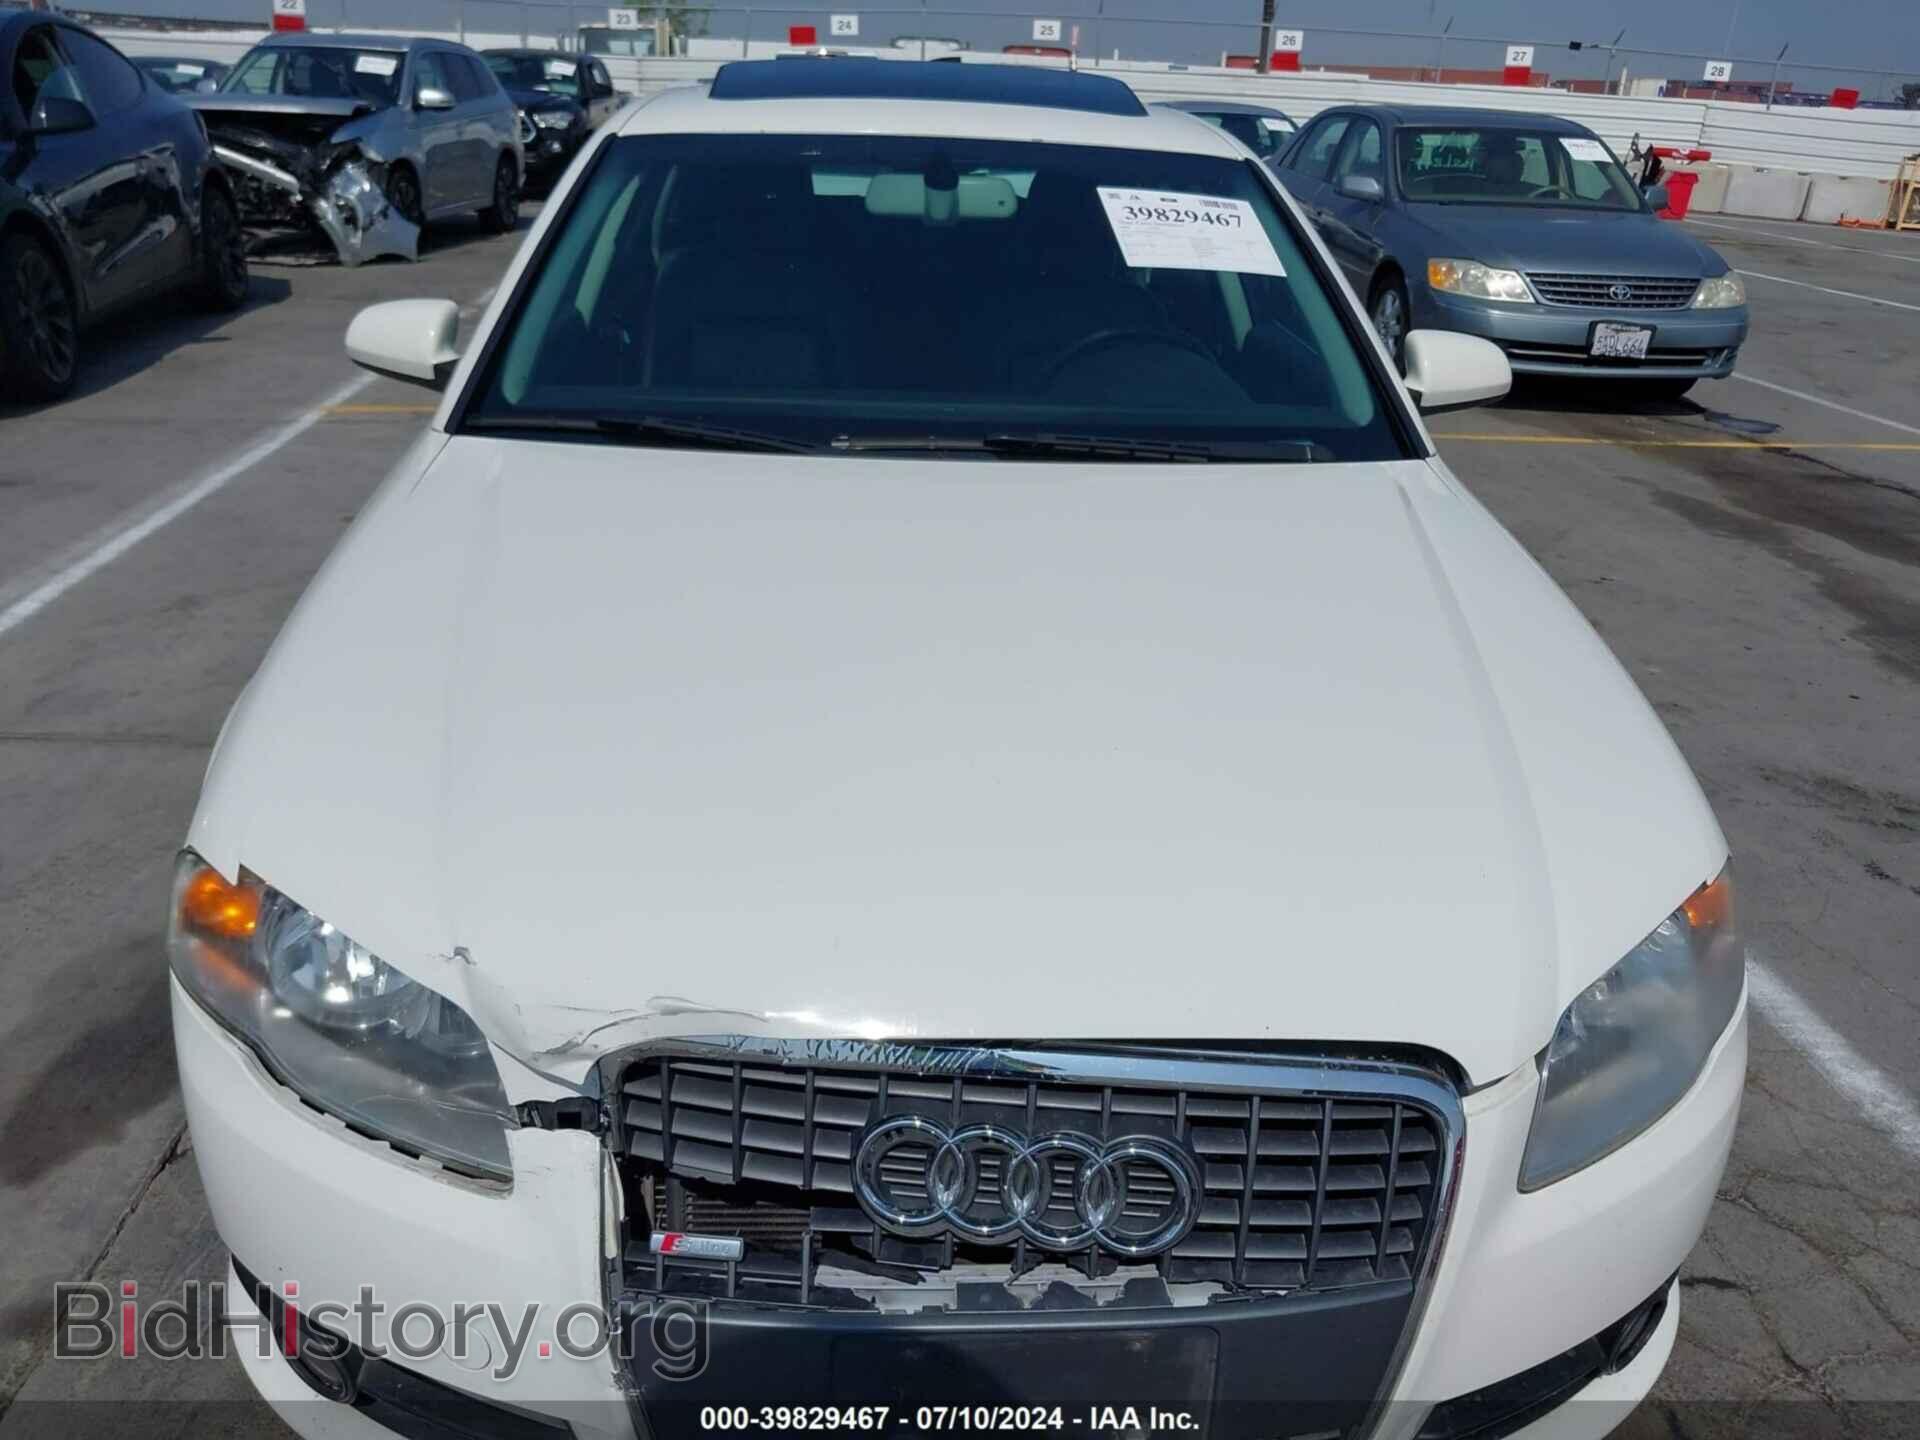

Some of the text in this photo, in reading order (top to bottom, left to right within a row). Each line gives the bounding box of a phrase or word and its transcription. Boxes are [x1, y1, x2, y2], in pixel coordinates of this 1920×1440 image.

[280, 0, 297, 9] 22
[617, 14, 631, 25] 23
[838, 20, 852, 31] 24
[1041, 25, 1055, 36] 25
[1281, 35, 1296, 46] 26
[1512, 51, 1527, 62] 27
[1711, 66, 1725, 77] 28
[1121, 205, 1242, 228] 39829467
